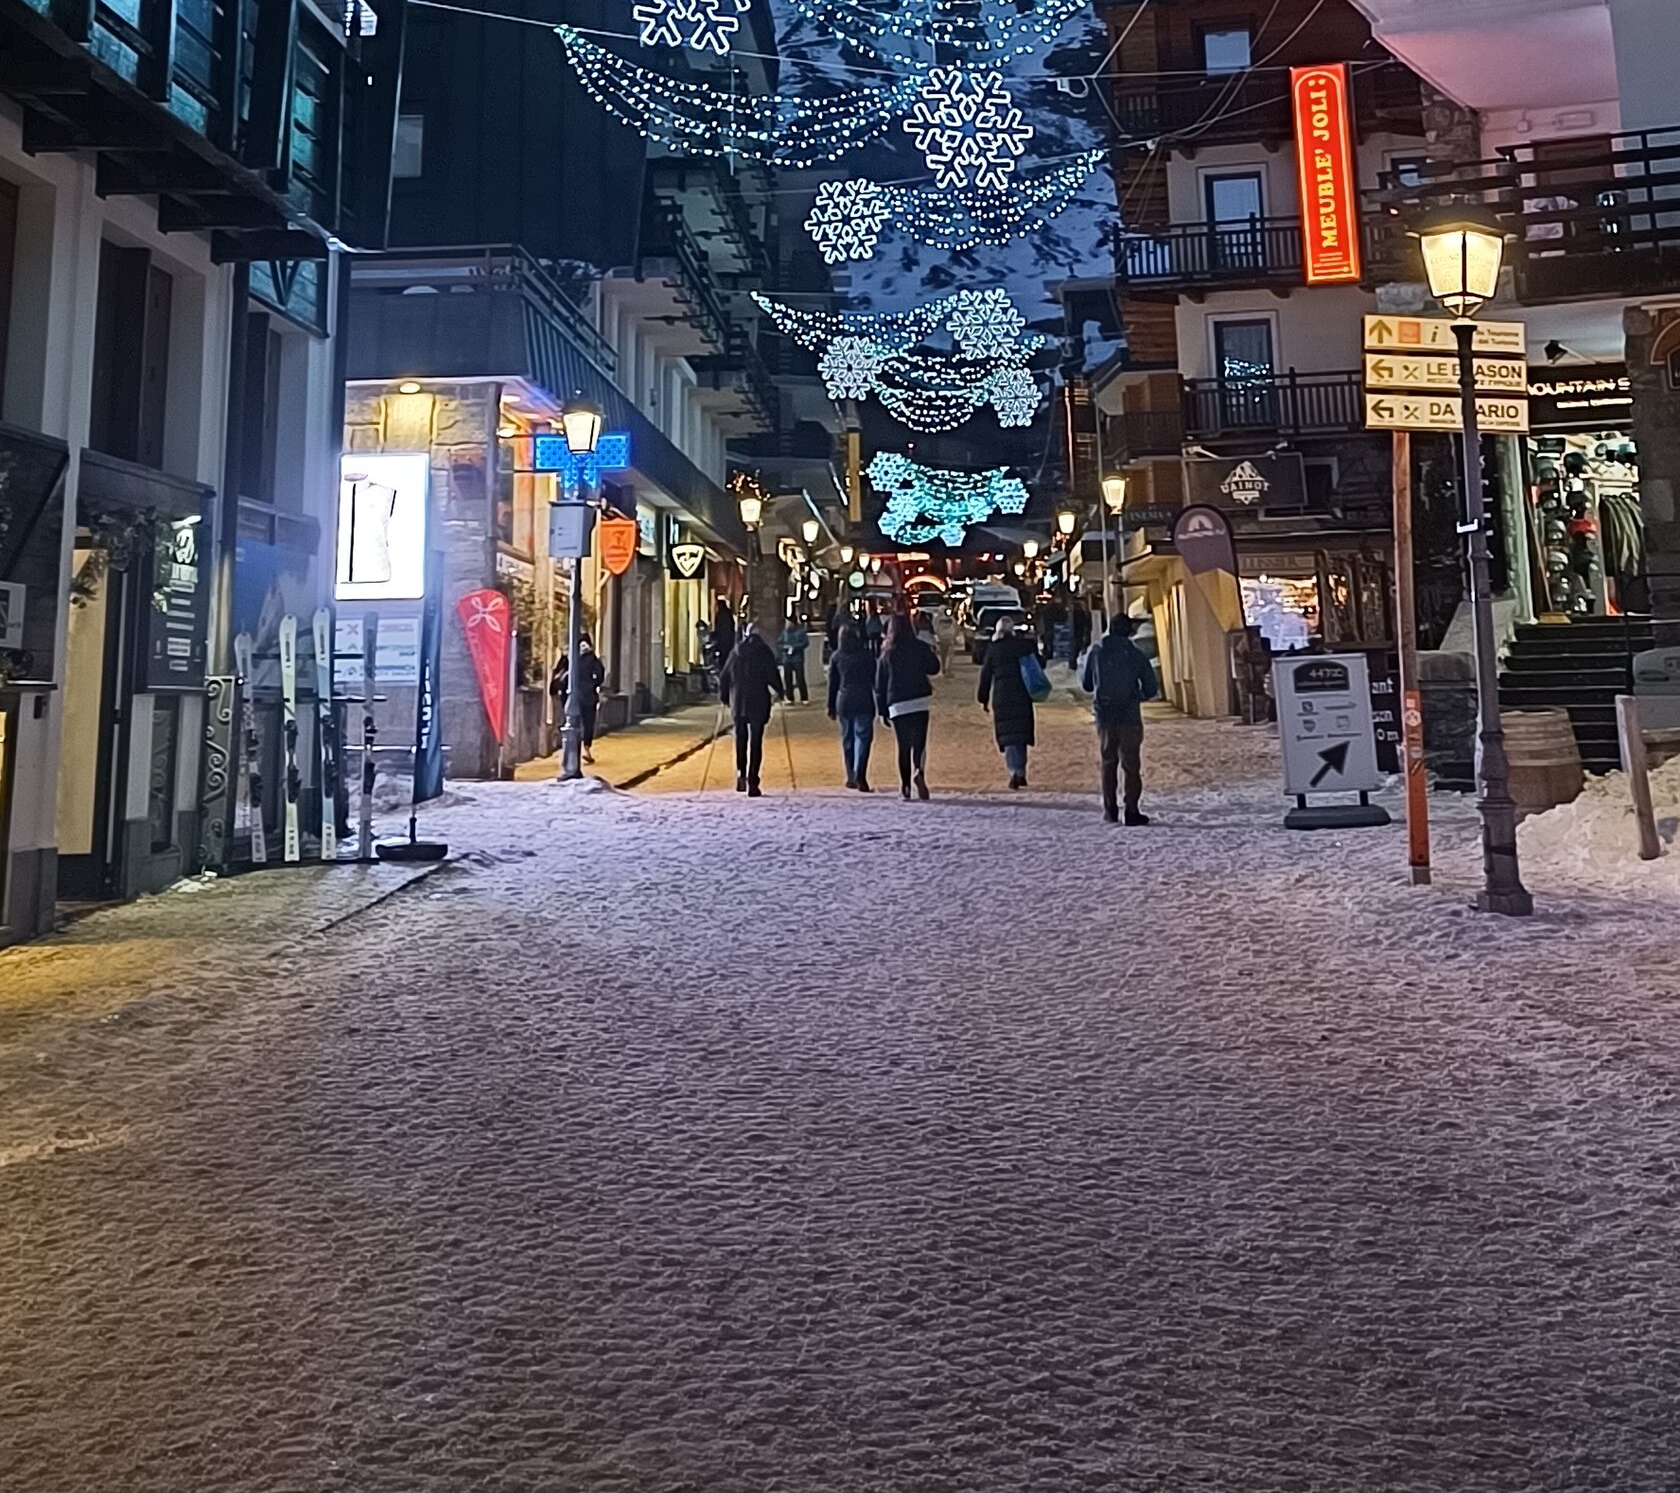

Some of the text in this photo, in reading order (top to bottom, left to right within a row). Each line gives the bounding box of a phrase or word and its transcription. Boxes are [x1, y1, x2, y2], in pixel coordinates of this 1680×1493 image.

[1310, 89, 1339, 248] MEUBLE' JOLI
[1426, 363, 1448, 376] LE
[1429, 402, 1520, 419] DA ARIO
